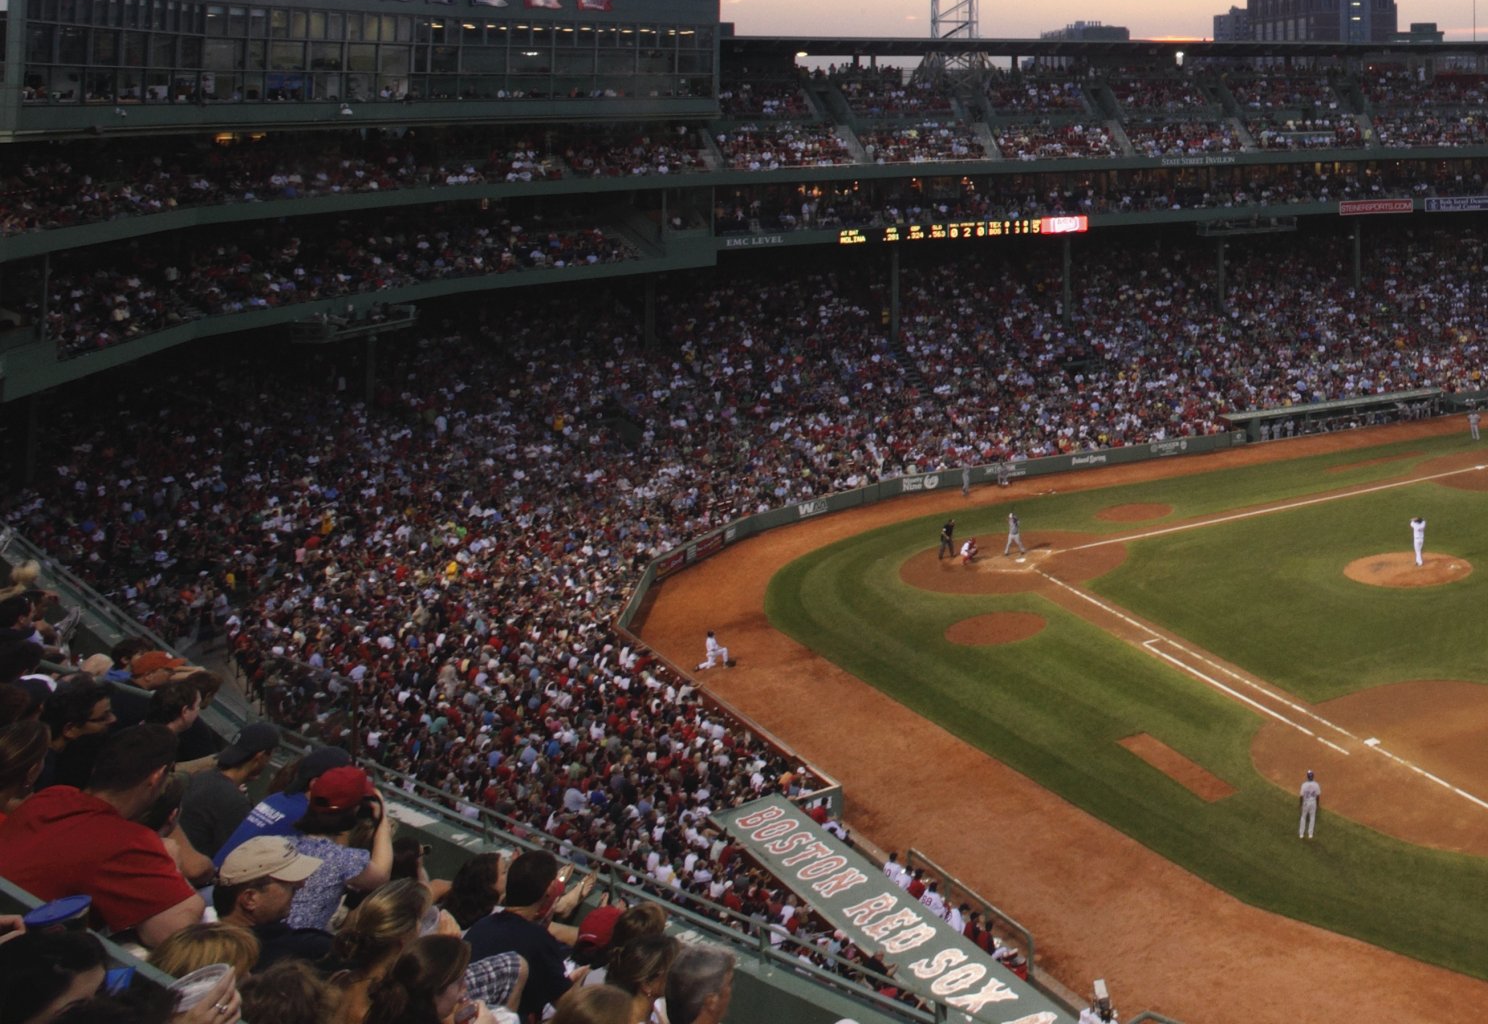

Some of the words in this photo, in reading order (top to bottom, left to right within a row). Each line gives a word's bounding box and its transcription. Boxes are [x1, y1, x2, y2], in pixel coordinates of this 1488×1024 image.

[1181, 157, 1204, 165] STREET
[1205, 156, 1235, 164] PAVILION
[950, 228, 958, 238] 0
[964, 228, 971, 237] 2
[977, 226, 985, 236] 0
[1032, 225, 1039, 233] 5
[726, 238, 749, 247] EMC
[752, 236, 784, 245] LEVEL
[840, 235, 866, 244] MOLINA
[736, 805, 868, 898] BOSTON
[843, 892, 936, 954] RED
[908, 948, 1019, 1014] SOX
